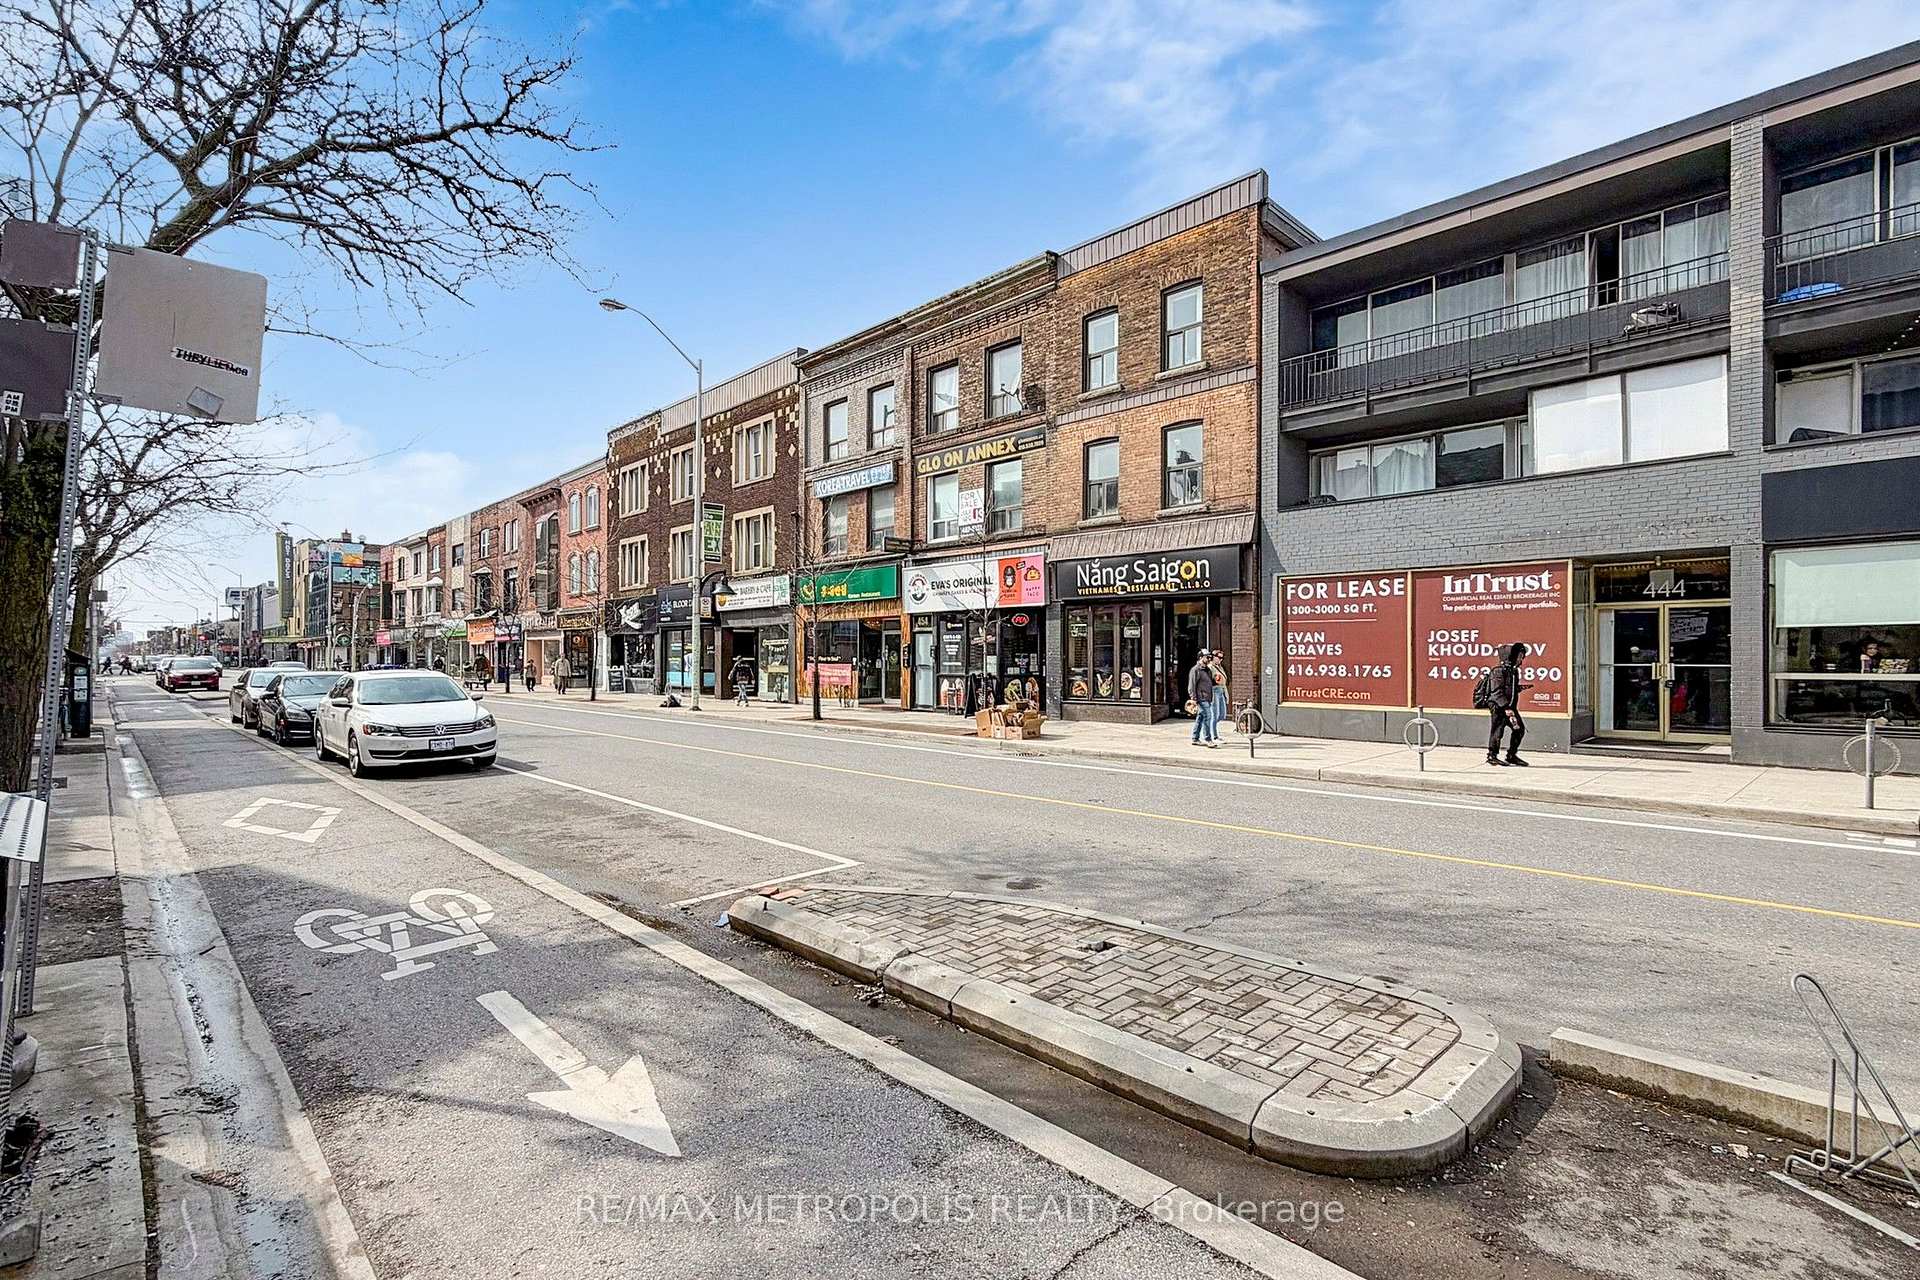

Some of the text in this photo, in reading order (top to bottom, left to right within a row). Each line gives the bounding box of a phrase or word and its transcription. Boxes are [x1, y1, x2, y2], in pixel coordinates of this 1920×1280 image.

[917, 455, 941, 473] GLO
[944, 452, 964, 468] ON
[966, 436, 1017, 462] ANNEX
[842, 471, 871, 489] TRAVEL
[1133, 557, 1210, 592] Saigon
[930, 577, 994, 590] EVA'S ORIGINAL
[1077, 585, 1123, 595] VIETNAMESE
[1126, 583, 1175, 592] RESTAURANT
[1286, 577, 1405, 600] FOR LEASE
[1642, 579, 1687, 598] 444
[672, 599, 689, 608] BLOOR
[1286, 603, 1378, 615] 1300-3000 SQ FT.
[1454, 603, 1476, 612] perfect
[1477, 602, 1503, 610] addition
[1287, 631, 1325, 643] EVAN
[1427, 630, 1479, 642] JOSEF
[1286, 643, 1343, 656] GRAVES
[1287, 664, 1392, 678] 416.938.1765
[1286, 687, 1371, 700] InTrustCRE.com
